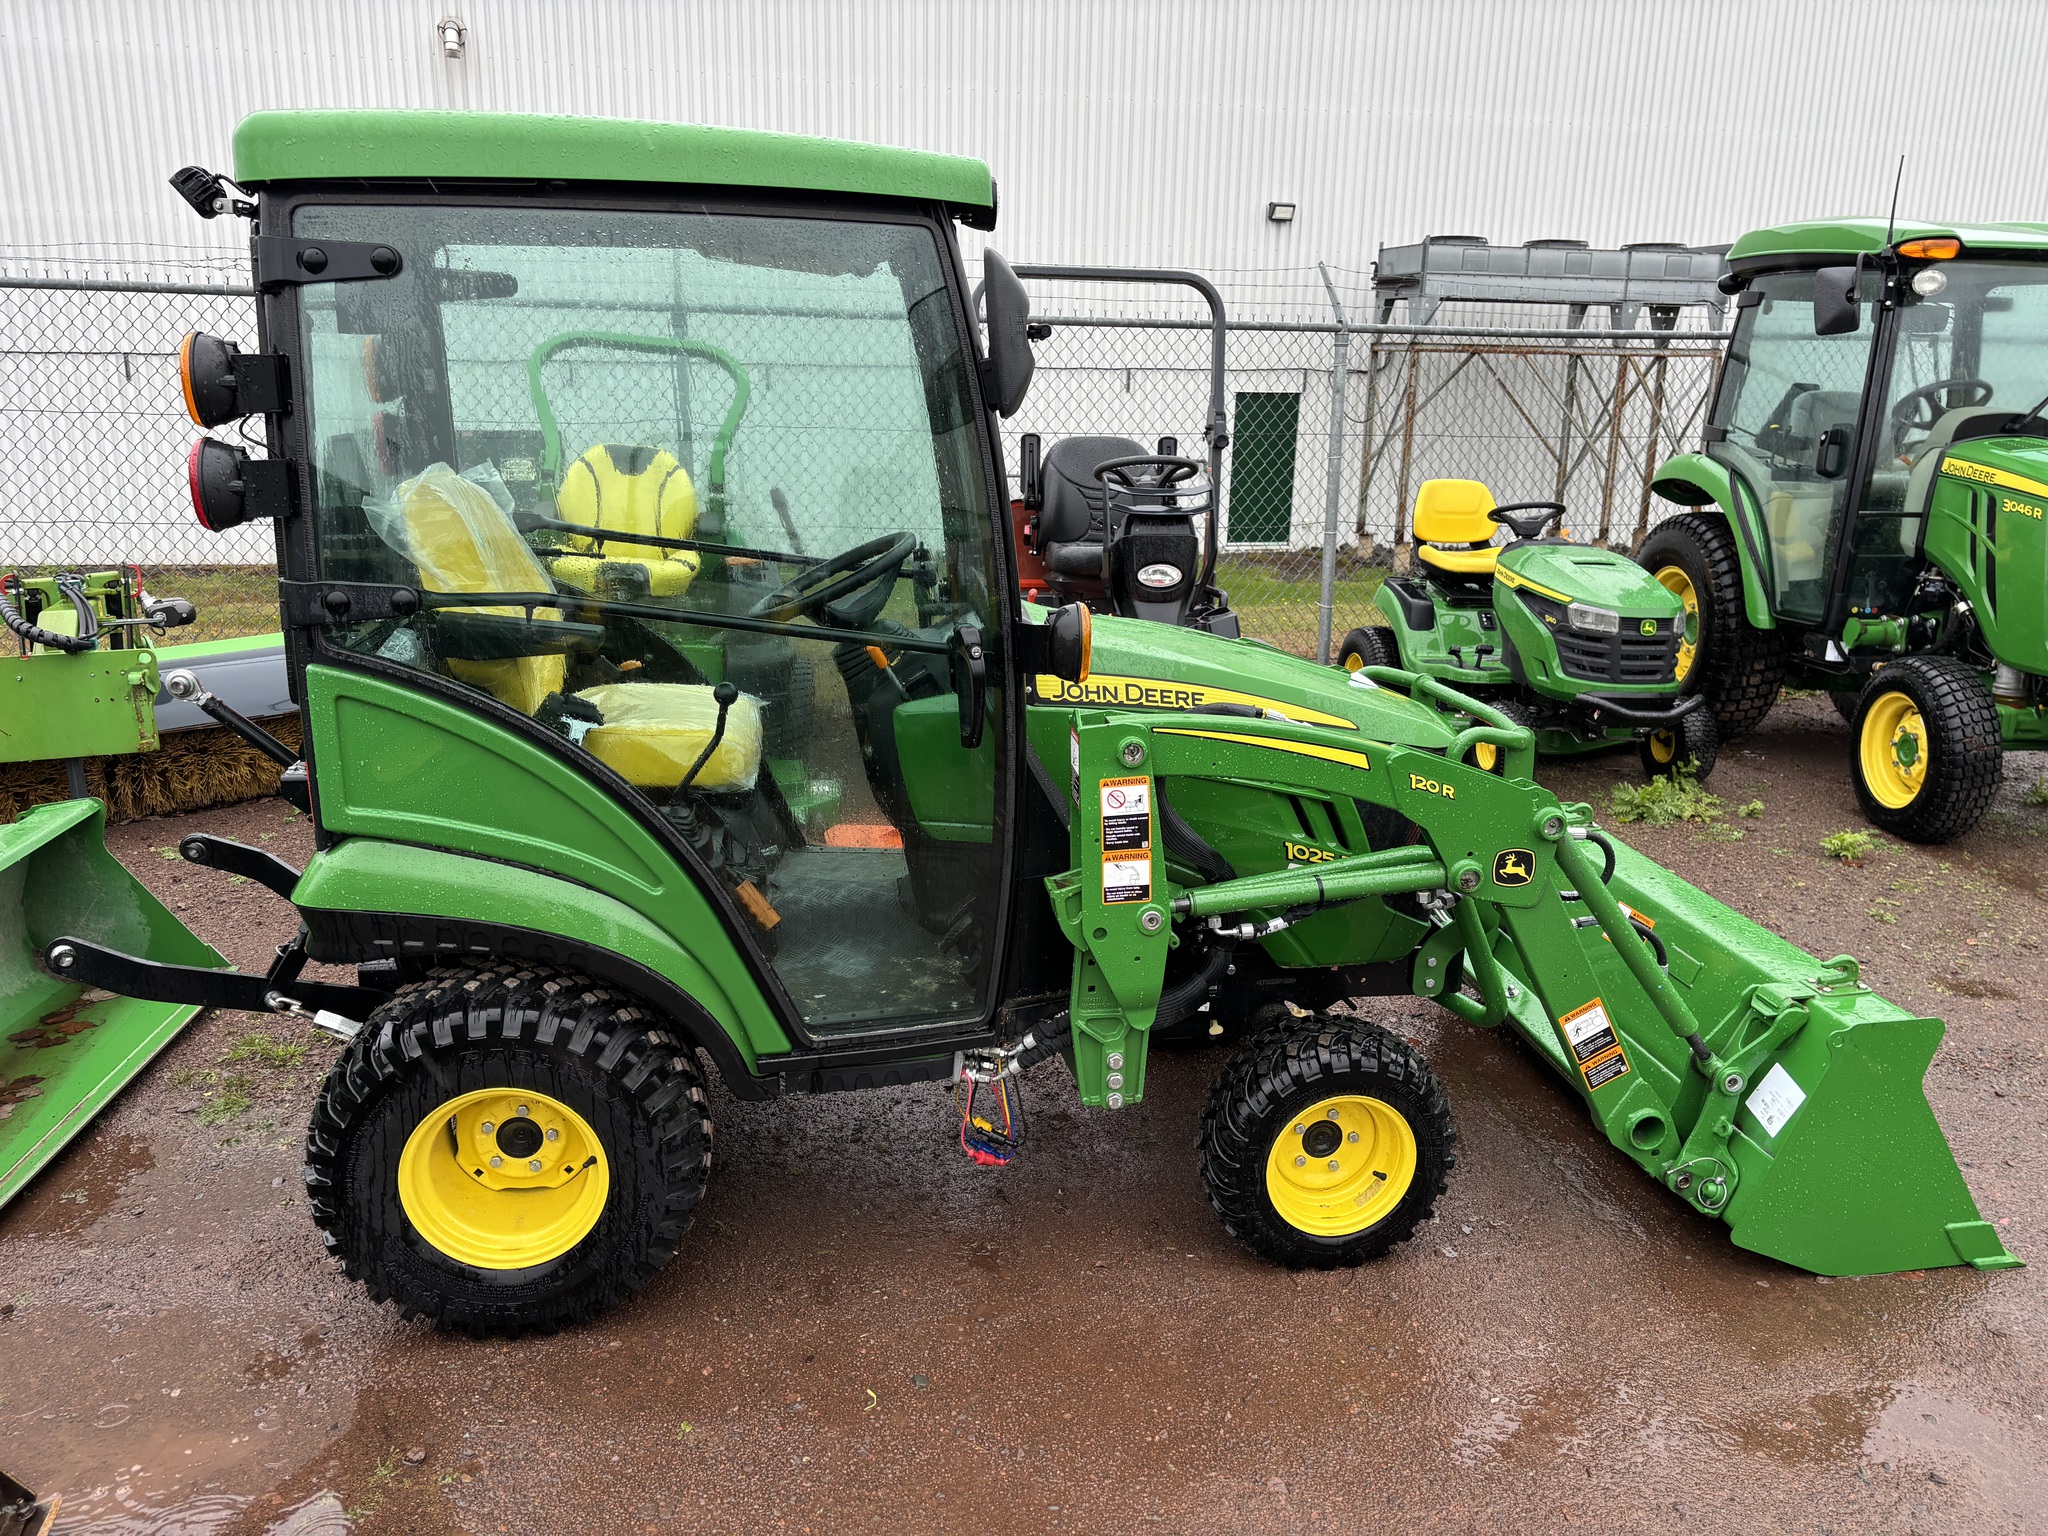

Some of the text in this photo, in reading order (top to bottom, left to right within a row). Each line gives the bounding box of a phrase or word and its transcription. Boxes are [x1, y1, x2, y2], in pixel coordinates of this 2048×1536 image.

[1944, 461, 1997, 482] JOHN DEERE
[2002, 498, 2043, 520] 3046 R
[1053, 680, 1205, 707] JOHN DEERE
[1109, 777, 1147, 787] WARNING
[1408, 772, 1456, 800] 120 R
[1111, 852, 1149, 861] WARNING
[1570, 1002, 1597, 1019] WARNING
[1591, 1049, 1618, 1066] WARNING
